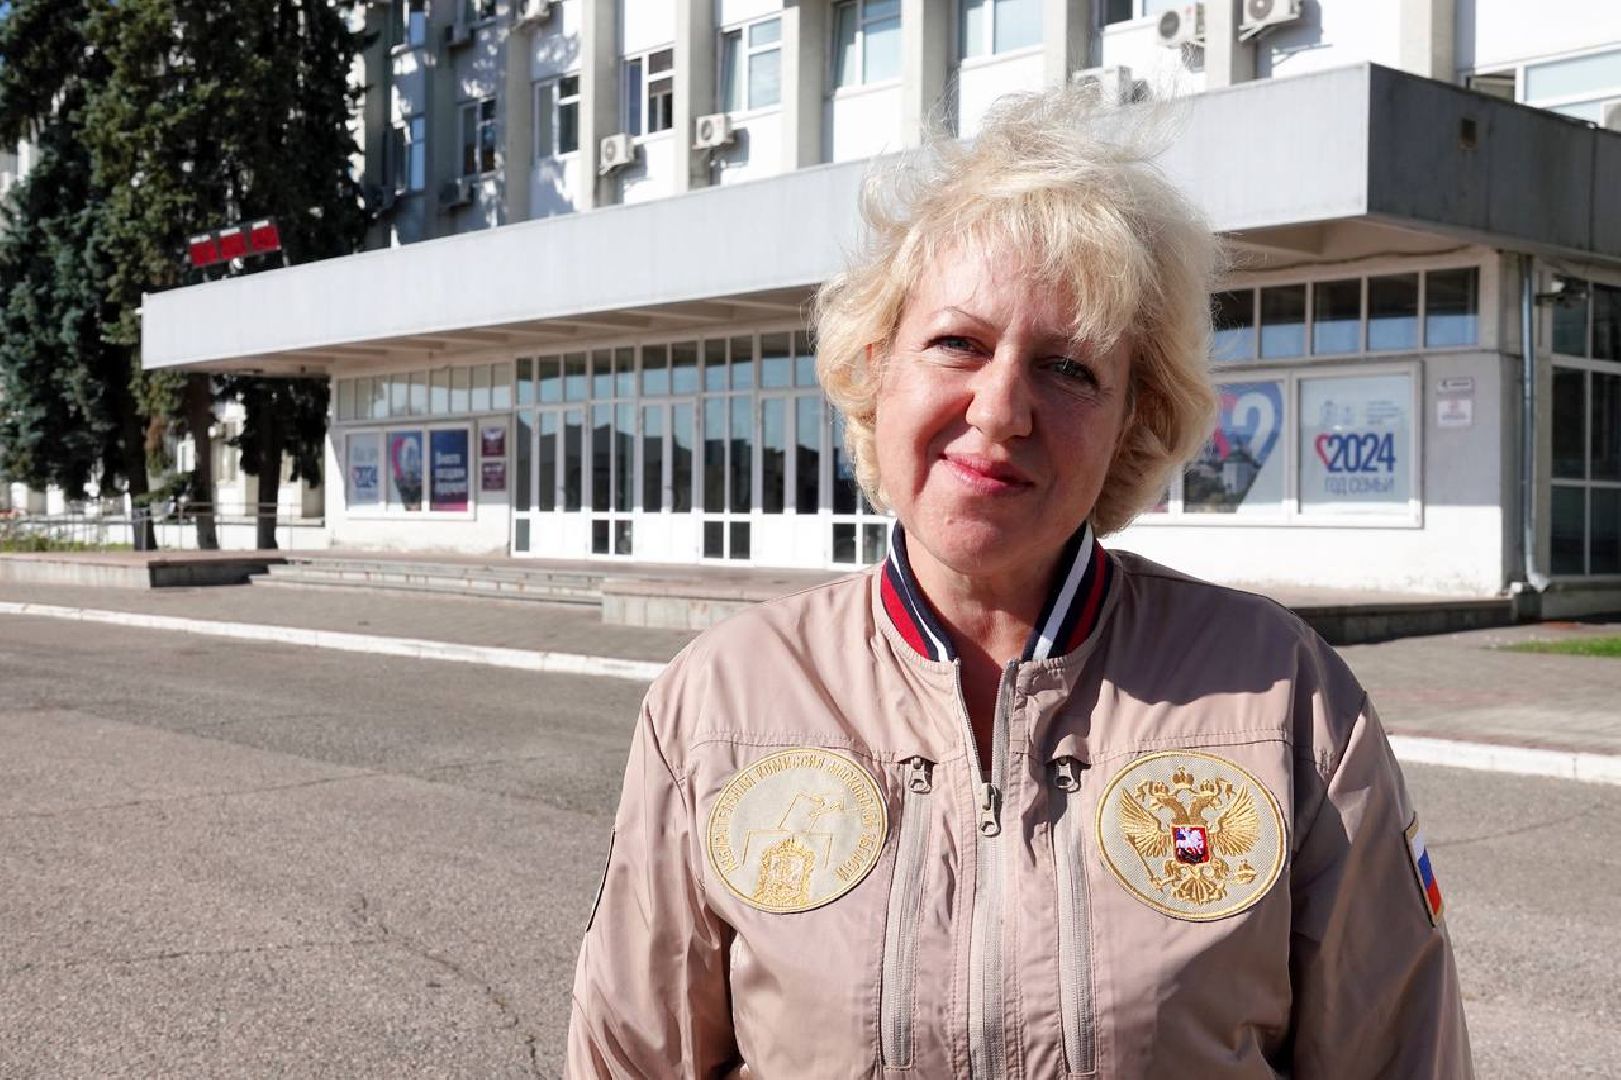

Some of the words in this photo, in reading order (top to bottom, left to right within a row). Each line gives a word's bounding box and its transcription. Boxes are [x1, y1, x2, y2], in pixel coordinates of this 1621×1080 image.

[1327, 432, 1396, 473] 2024
[1324, 477, 1347, 496] ГОД
[756, 755, 825, 779] КОМИССИЯ
